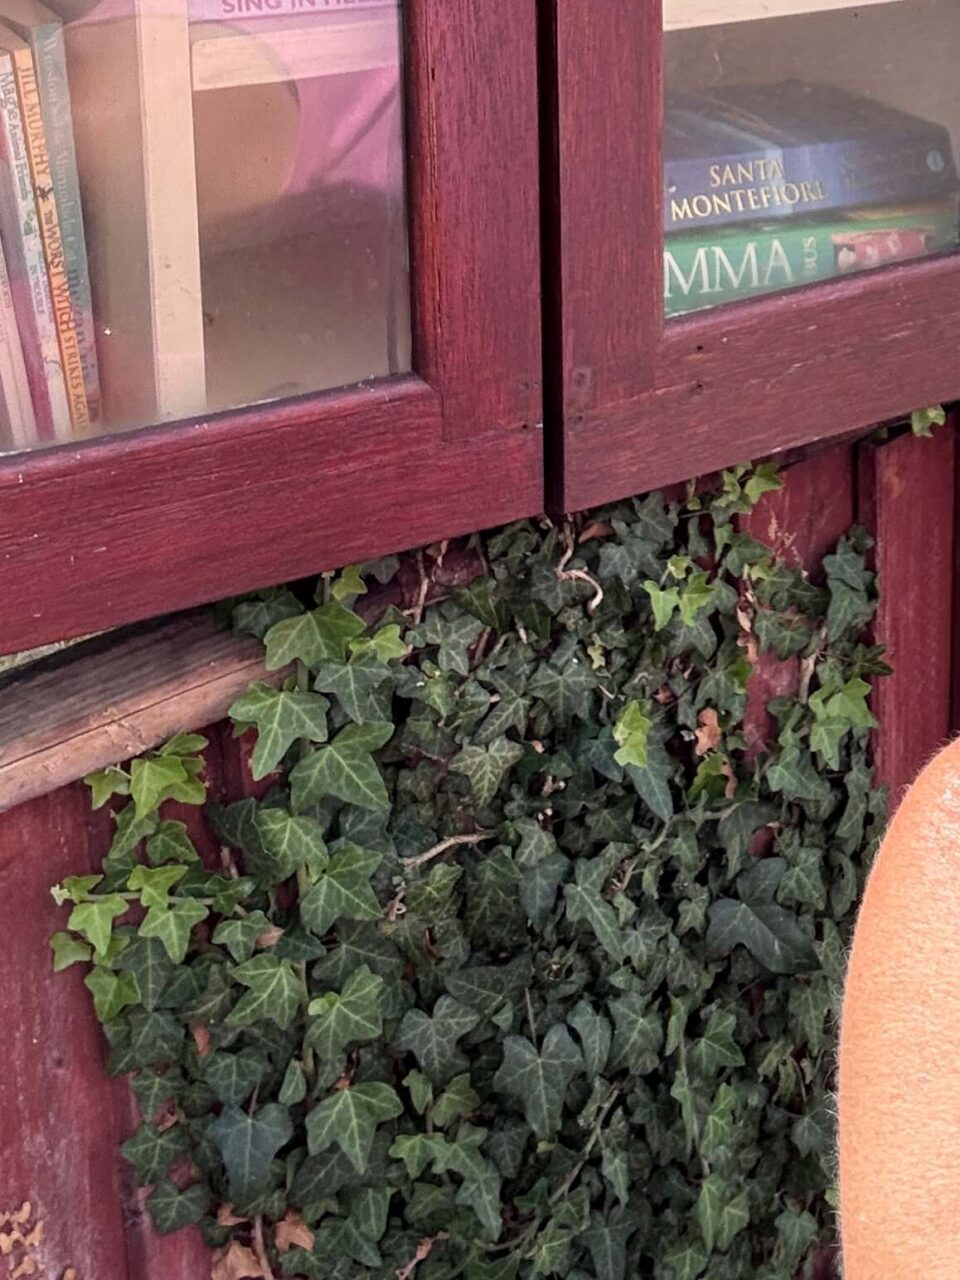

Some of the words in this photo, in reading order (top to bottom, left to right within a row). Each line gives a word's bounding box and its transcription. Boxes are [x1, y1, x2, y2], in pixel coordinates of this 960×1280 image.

[0, 71, 20, 121] Magic
[18, 65, 37, 98] JILL
[25, 103, 51, 178] MURPHY
[709, 157, 785, 189] SANTA
[45, 222, 66, 282] WORST
[53, 279, 77, 331] WITCH
[63, 334, 84, 391] STRIKES
